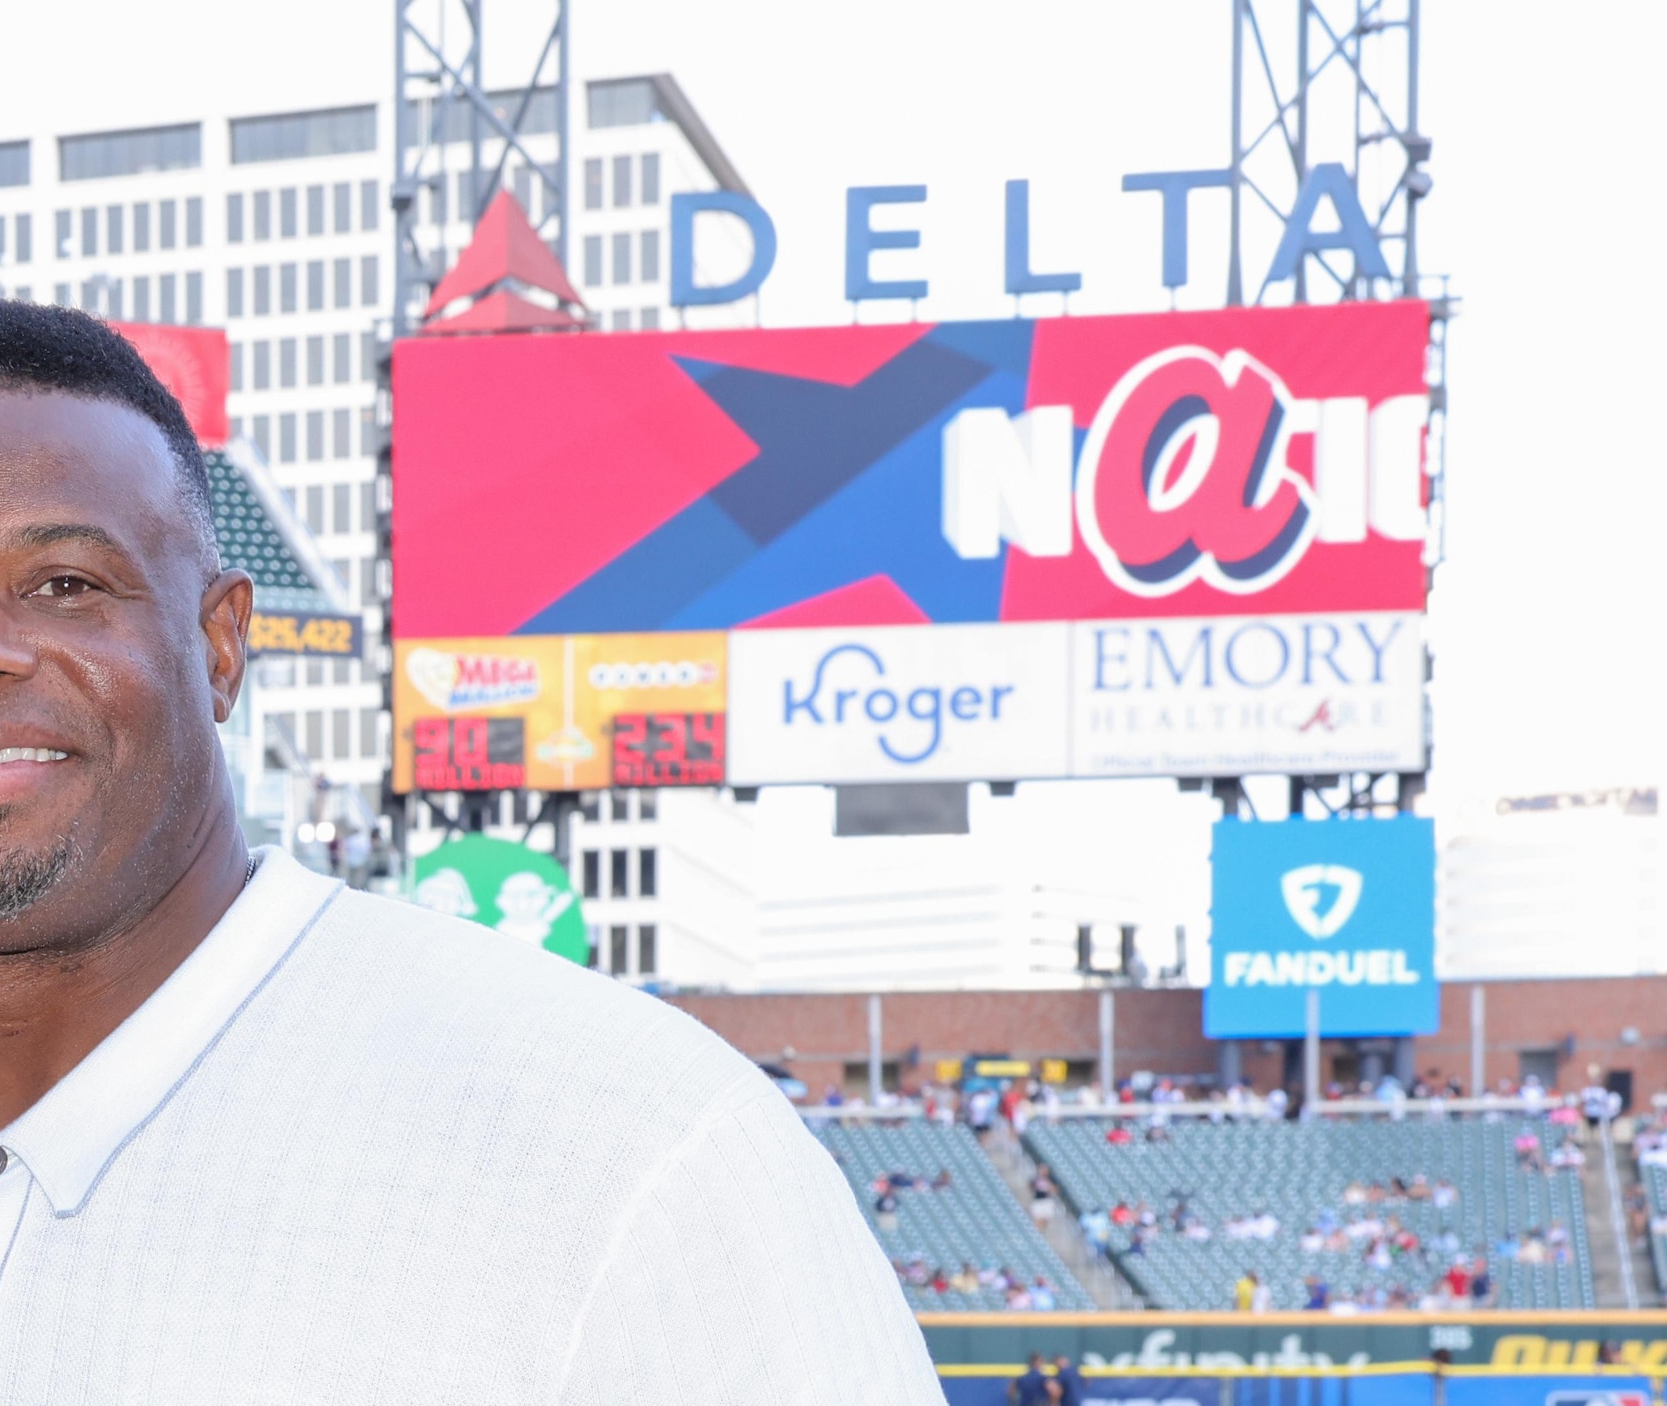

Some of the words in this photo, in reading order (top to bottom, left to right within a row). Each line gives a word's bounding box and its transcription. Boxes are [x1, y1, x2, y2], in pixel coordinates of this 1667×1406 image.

[670, 163, 1392, 306] DELTA
[1091, 620, 1402, 693] EMORY
[783, 643, 1014, 764] Kroger
[414, 718, 489, 764] 90
[613, 712, 726, 763] 234
[1223, 949, 1420, 987] FANDUEL
